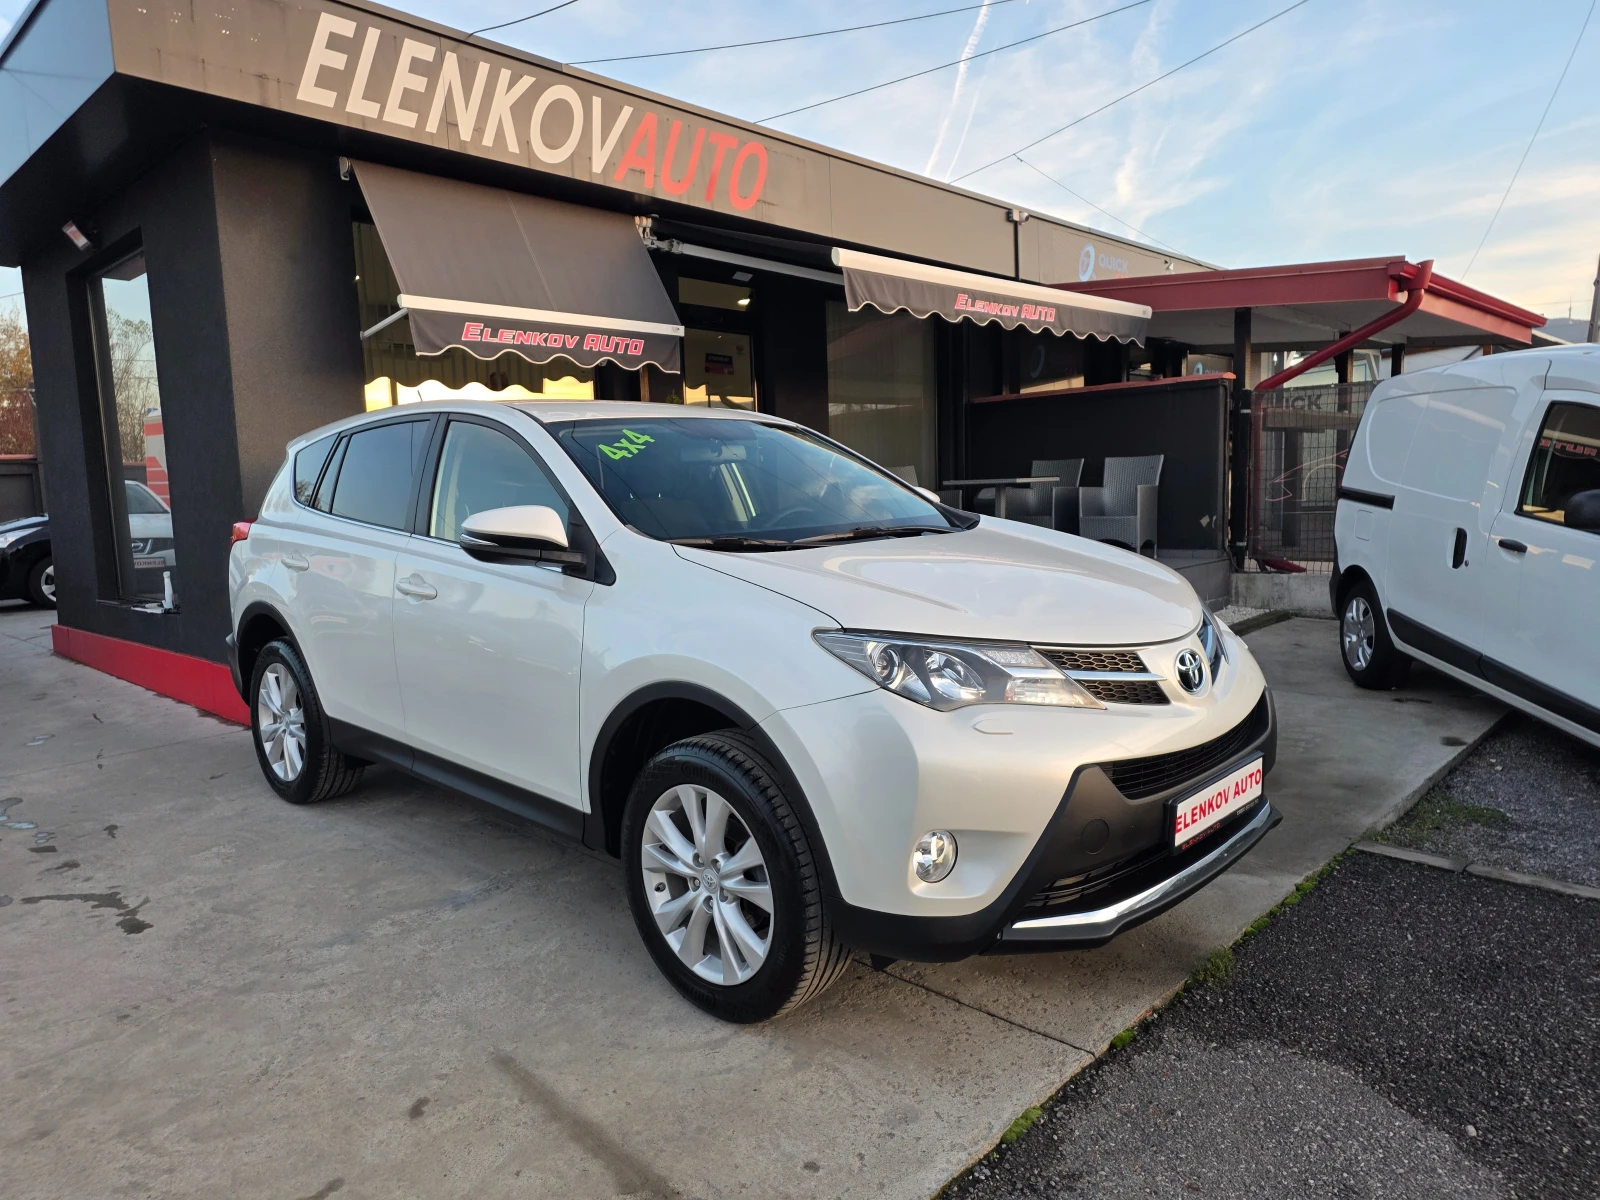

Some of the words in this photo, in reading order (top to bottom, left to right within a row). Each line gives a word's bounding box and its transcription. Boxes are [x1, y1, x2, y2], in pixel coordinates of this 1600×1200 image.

[1020, 303, 1055, 322] AUTO
[461, 321, 580, 348] ELENKOV
[583, 333, 645, 356] AUTO
[1175, 785, 1231, 834] ELENKOV
[1232, 768, 1262, 800] AUTO
